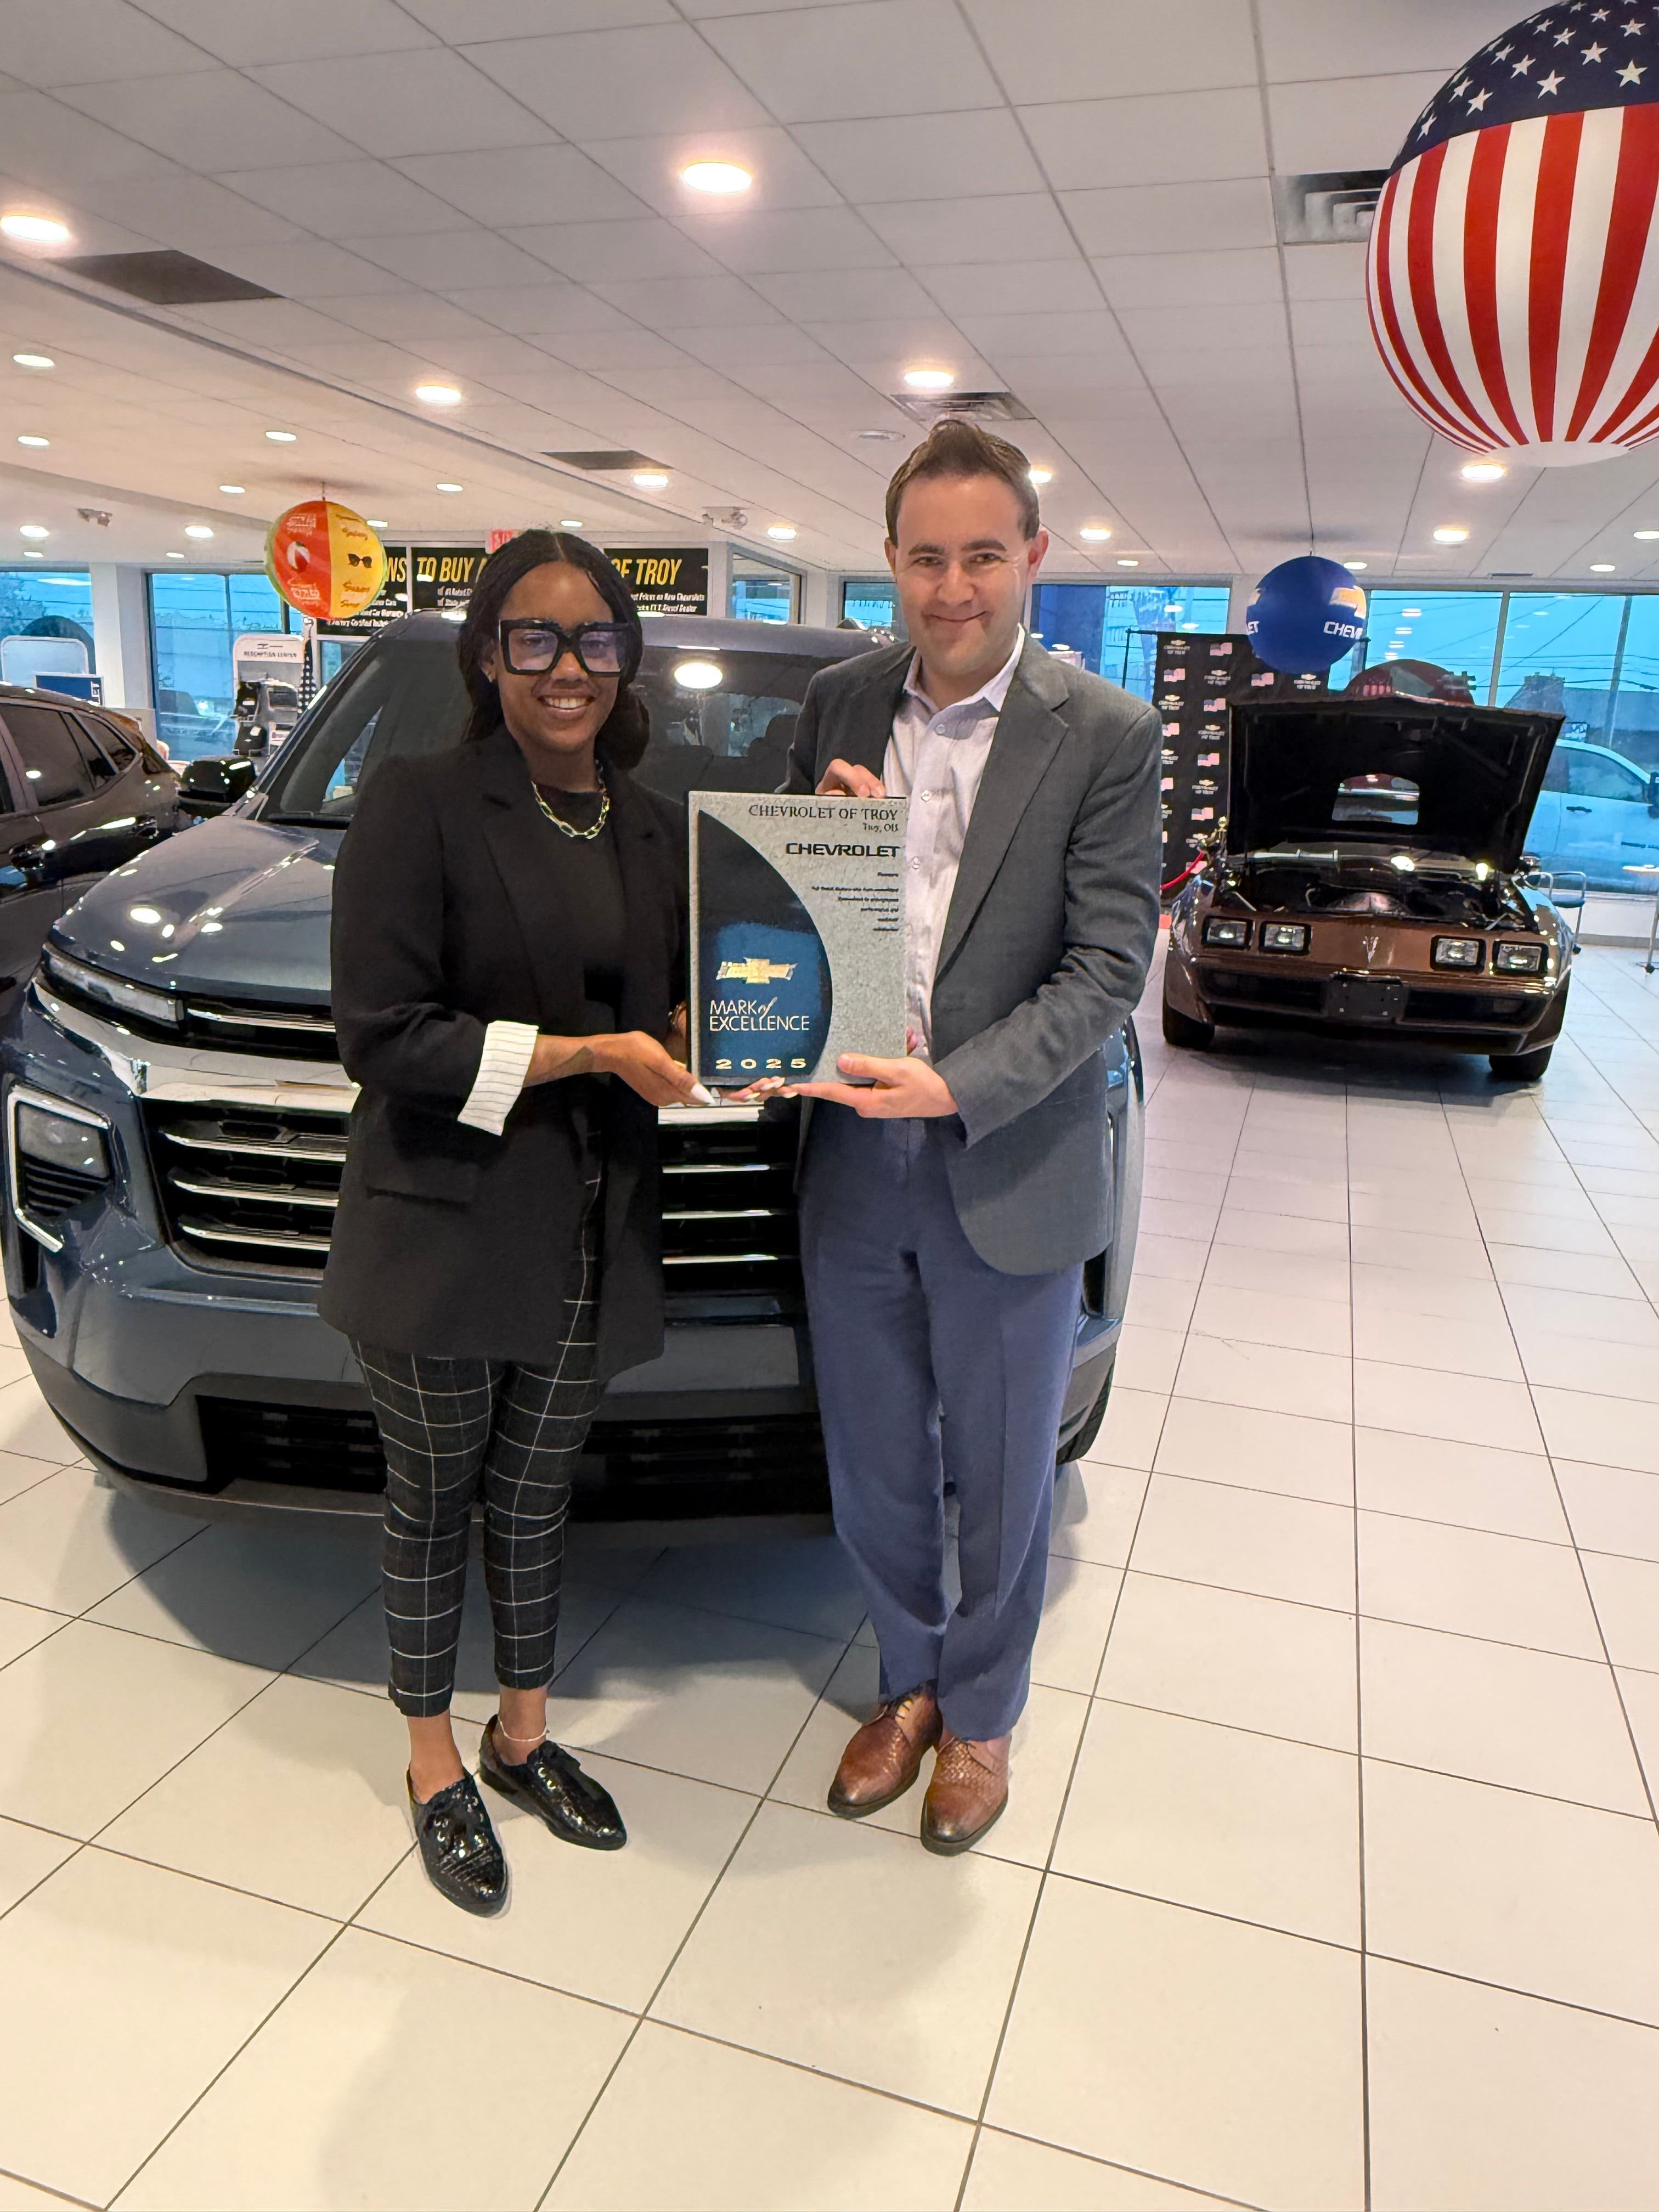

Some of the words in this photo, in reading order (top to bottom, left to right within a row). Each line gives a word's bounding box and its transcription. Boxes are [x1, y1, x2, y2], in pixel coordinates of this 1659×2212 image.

[439, 557, 475, 582] BUY
[636, 558, 682, 585] TROY
[748, 805, 836, 820] CHEVROLET
[838, 808, 857, 819] OF
[861, 809, 899, 821] TROY
[786, 843, 901, 859] CHEVROLET
[710, 999, 757, 1015] MARK
[709, 1015, 810, 1031] EXCELLENCE
[715, 1058, 806, 1070] 2025
